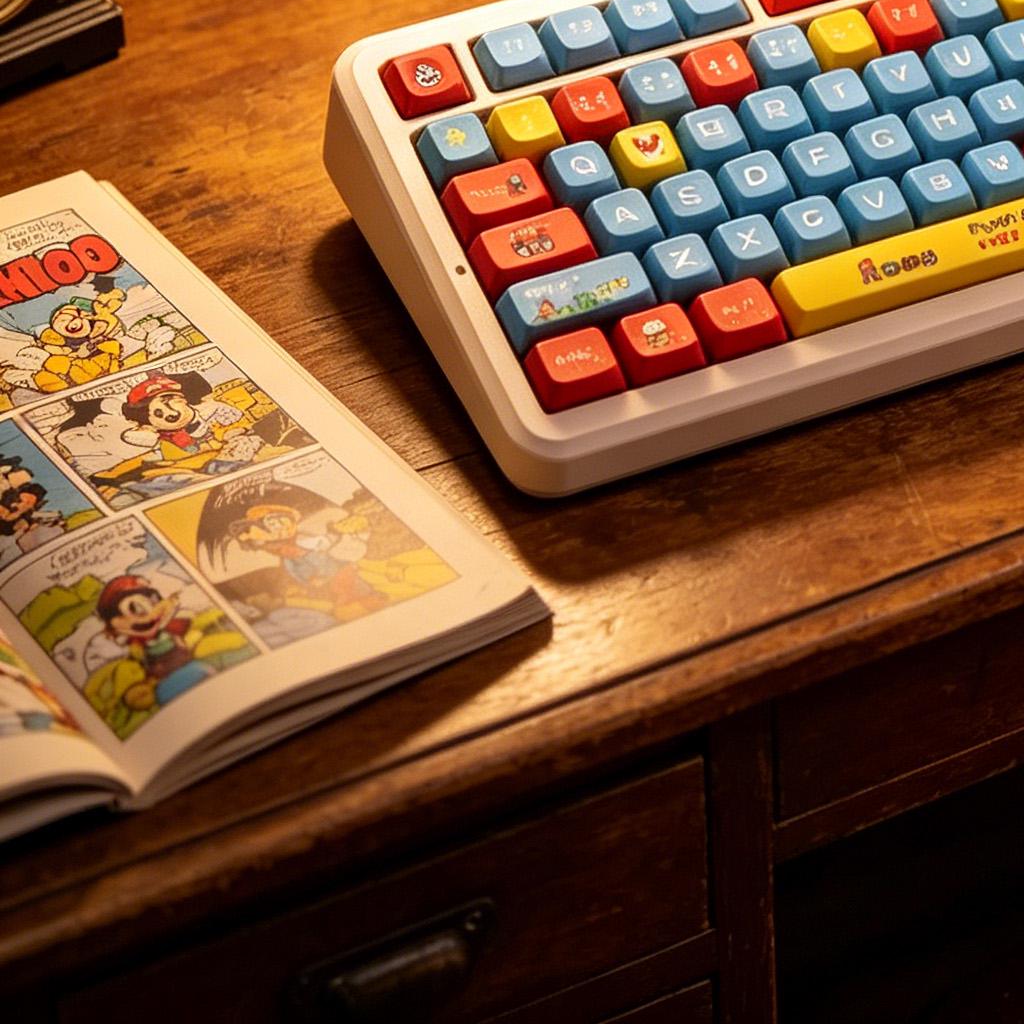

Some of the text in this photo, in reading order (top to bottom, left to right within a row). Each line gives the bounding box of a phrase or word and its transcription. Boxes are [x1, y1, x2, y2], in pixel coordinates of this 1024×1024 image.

[952, 46, 971, 67] U
[832, 82, 845, 99] T
[764, 99, 789, 119] R
[931, 108, 957, 130] H
[871, 129, 894, 148] G
[571, 156, 598, 174] Q
[809, 147, 829, 166] F
[744, 166, 767, 186] D
[678, 186, 702, 205] S
[862, 190, 884, 209] V
[615, 206, 639, 223] A
[802, 209, 824, 227] C
[737, 227, 761, 251] X
[669, 247, 698, 270] Z
